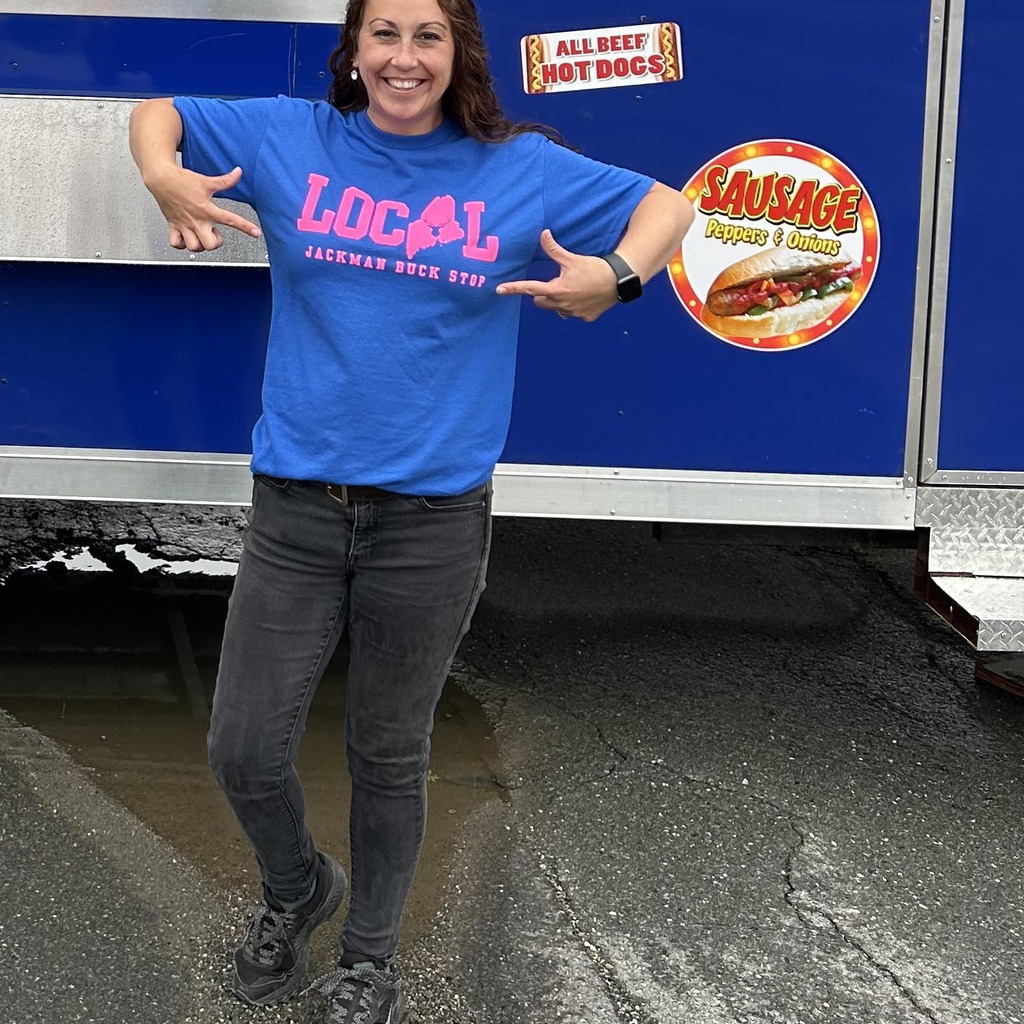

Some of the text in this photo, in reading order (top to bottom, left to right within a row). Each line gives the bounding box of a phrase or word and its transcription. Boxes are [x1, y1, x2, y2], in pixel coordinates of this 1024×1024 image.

[556, 33, 646, 57] ALL BEEF
[541, 54, 664, 85] HOT DOGS
[699, 164, 863, 234] SAUSAGE
[705, 218, 842, 256] Peppers & Onions
[305, 245, 487, 288] JACKMAN BUCK STOP
